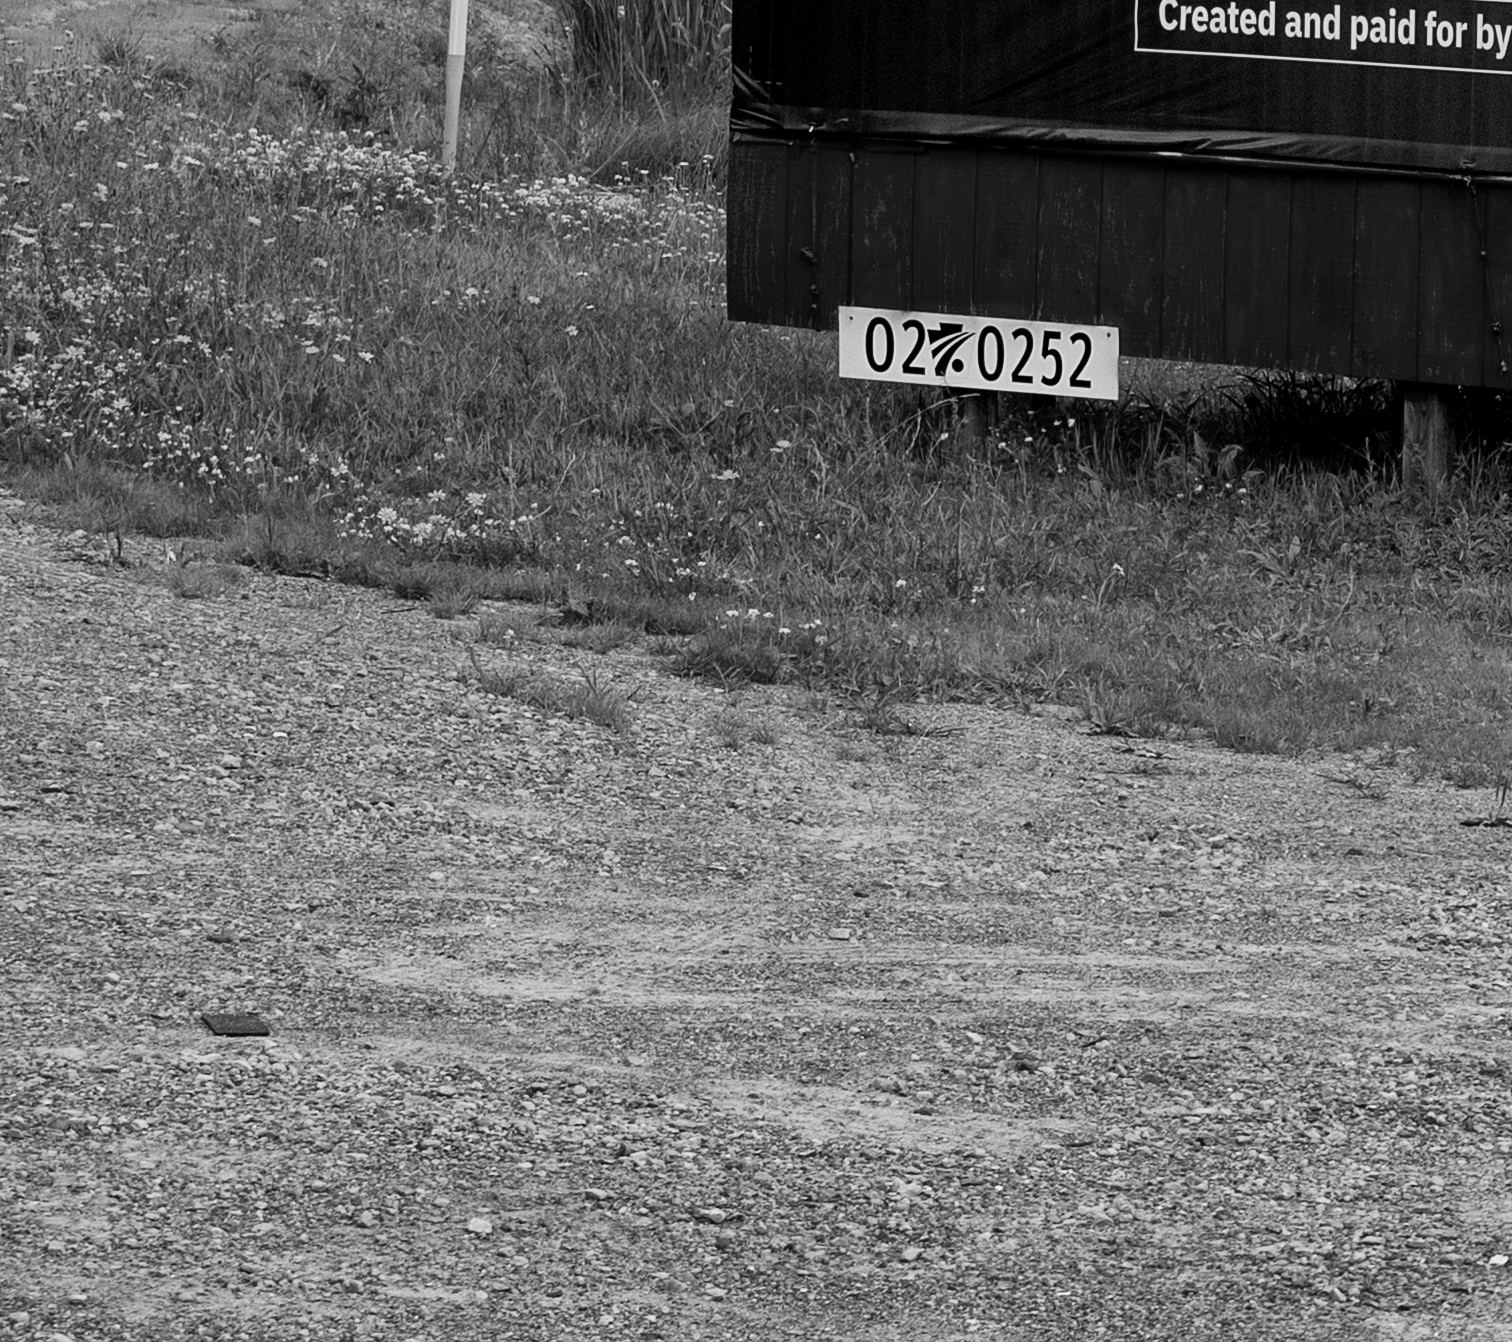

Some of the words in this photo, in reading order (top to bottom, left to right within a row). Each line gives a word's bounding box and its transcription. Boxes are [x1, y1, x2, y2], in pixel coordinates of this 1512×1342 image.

[1285, 2, 1340, 40] and
[1351, 7, 1415, 50] paid
[1425, 9, 1467, 47] for
[1477, 12, 1512, 59] by
